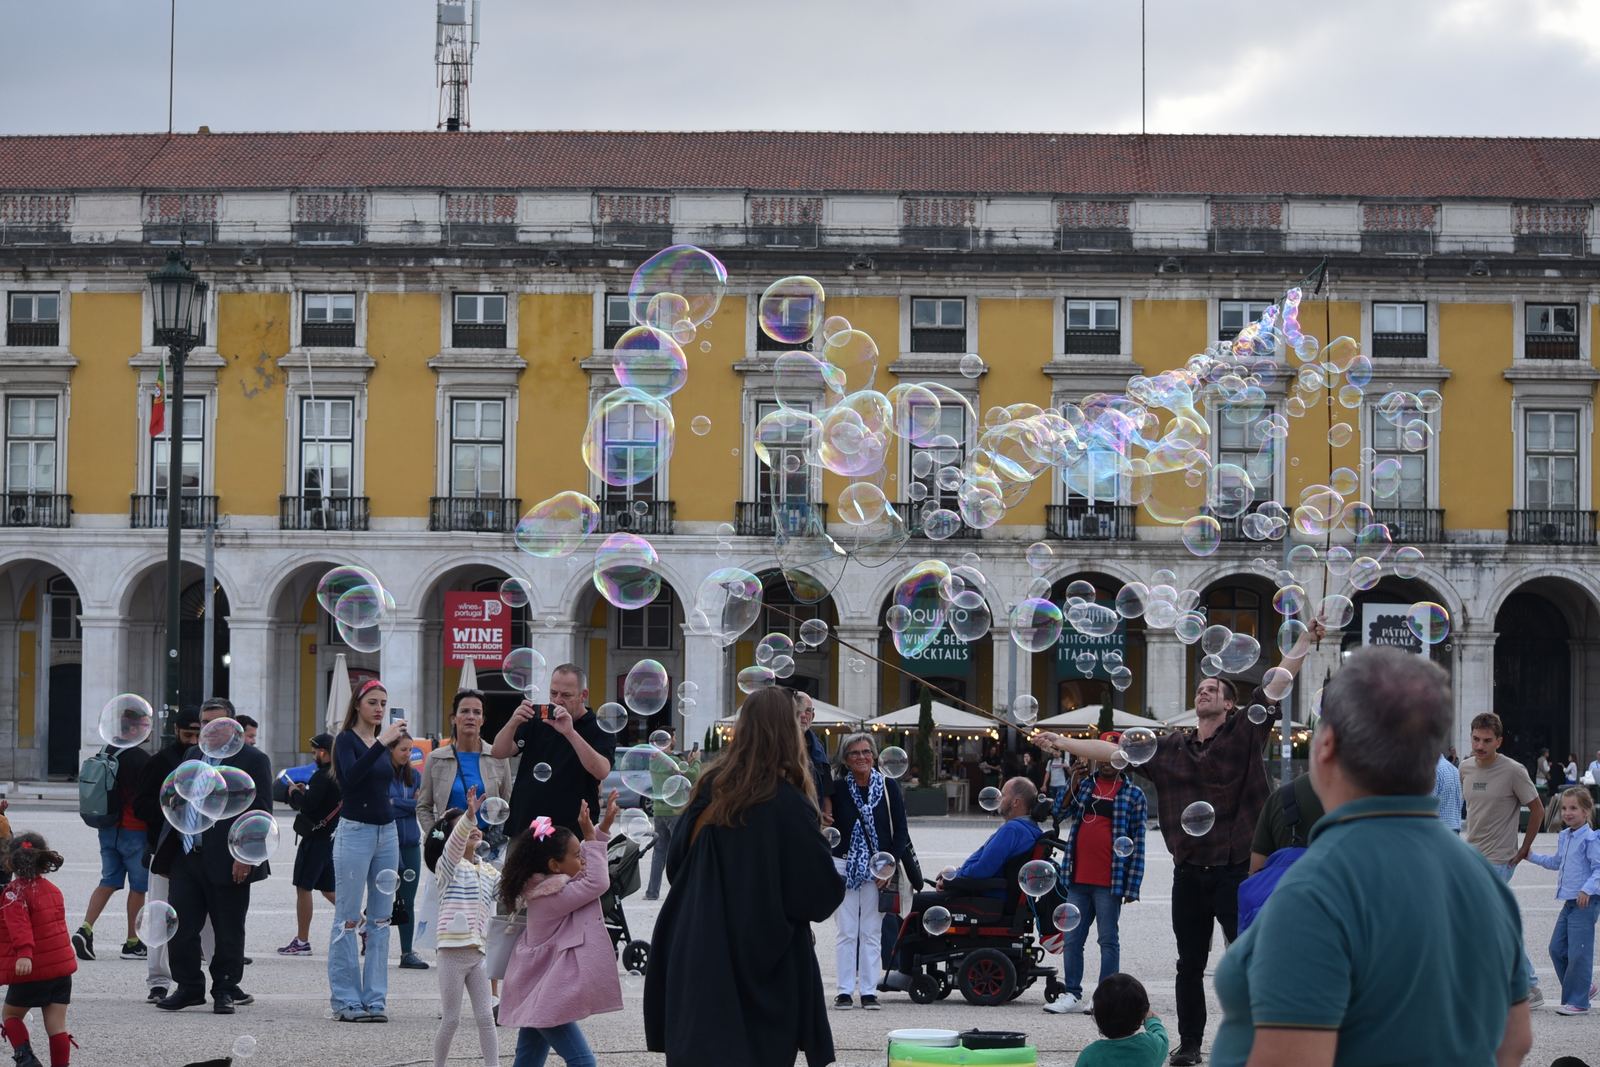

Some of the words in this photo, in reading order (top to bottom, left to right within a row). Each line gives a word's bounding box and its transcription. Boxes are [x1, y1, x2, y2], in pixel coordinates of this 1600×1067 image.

[454, 609, 482, 617] portugal
[453, 627, 502, 642] WINE
[1381, 626, 1410, 637] PÁTIO
[904, 634, 929, 645] WINE
[943, 634, 968, 645] BEER
[1059, 634, 1124, 644] RISTORANTE
[1376, 636, 1389, 646] DA
[1390, 635, 1415, 646] GALÉ
[904, 648, 968, 660] COCKTAILS
[1058, 648, 1124, 660] ITALIANO
